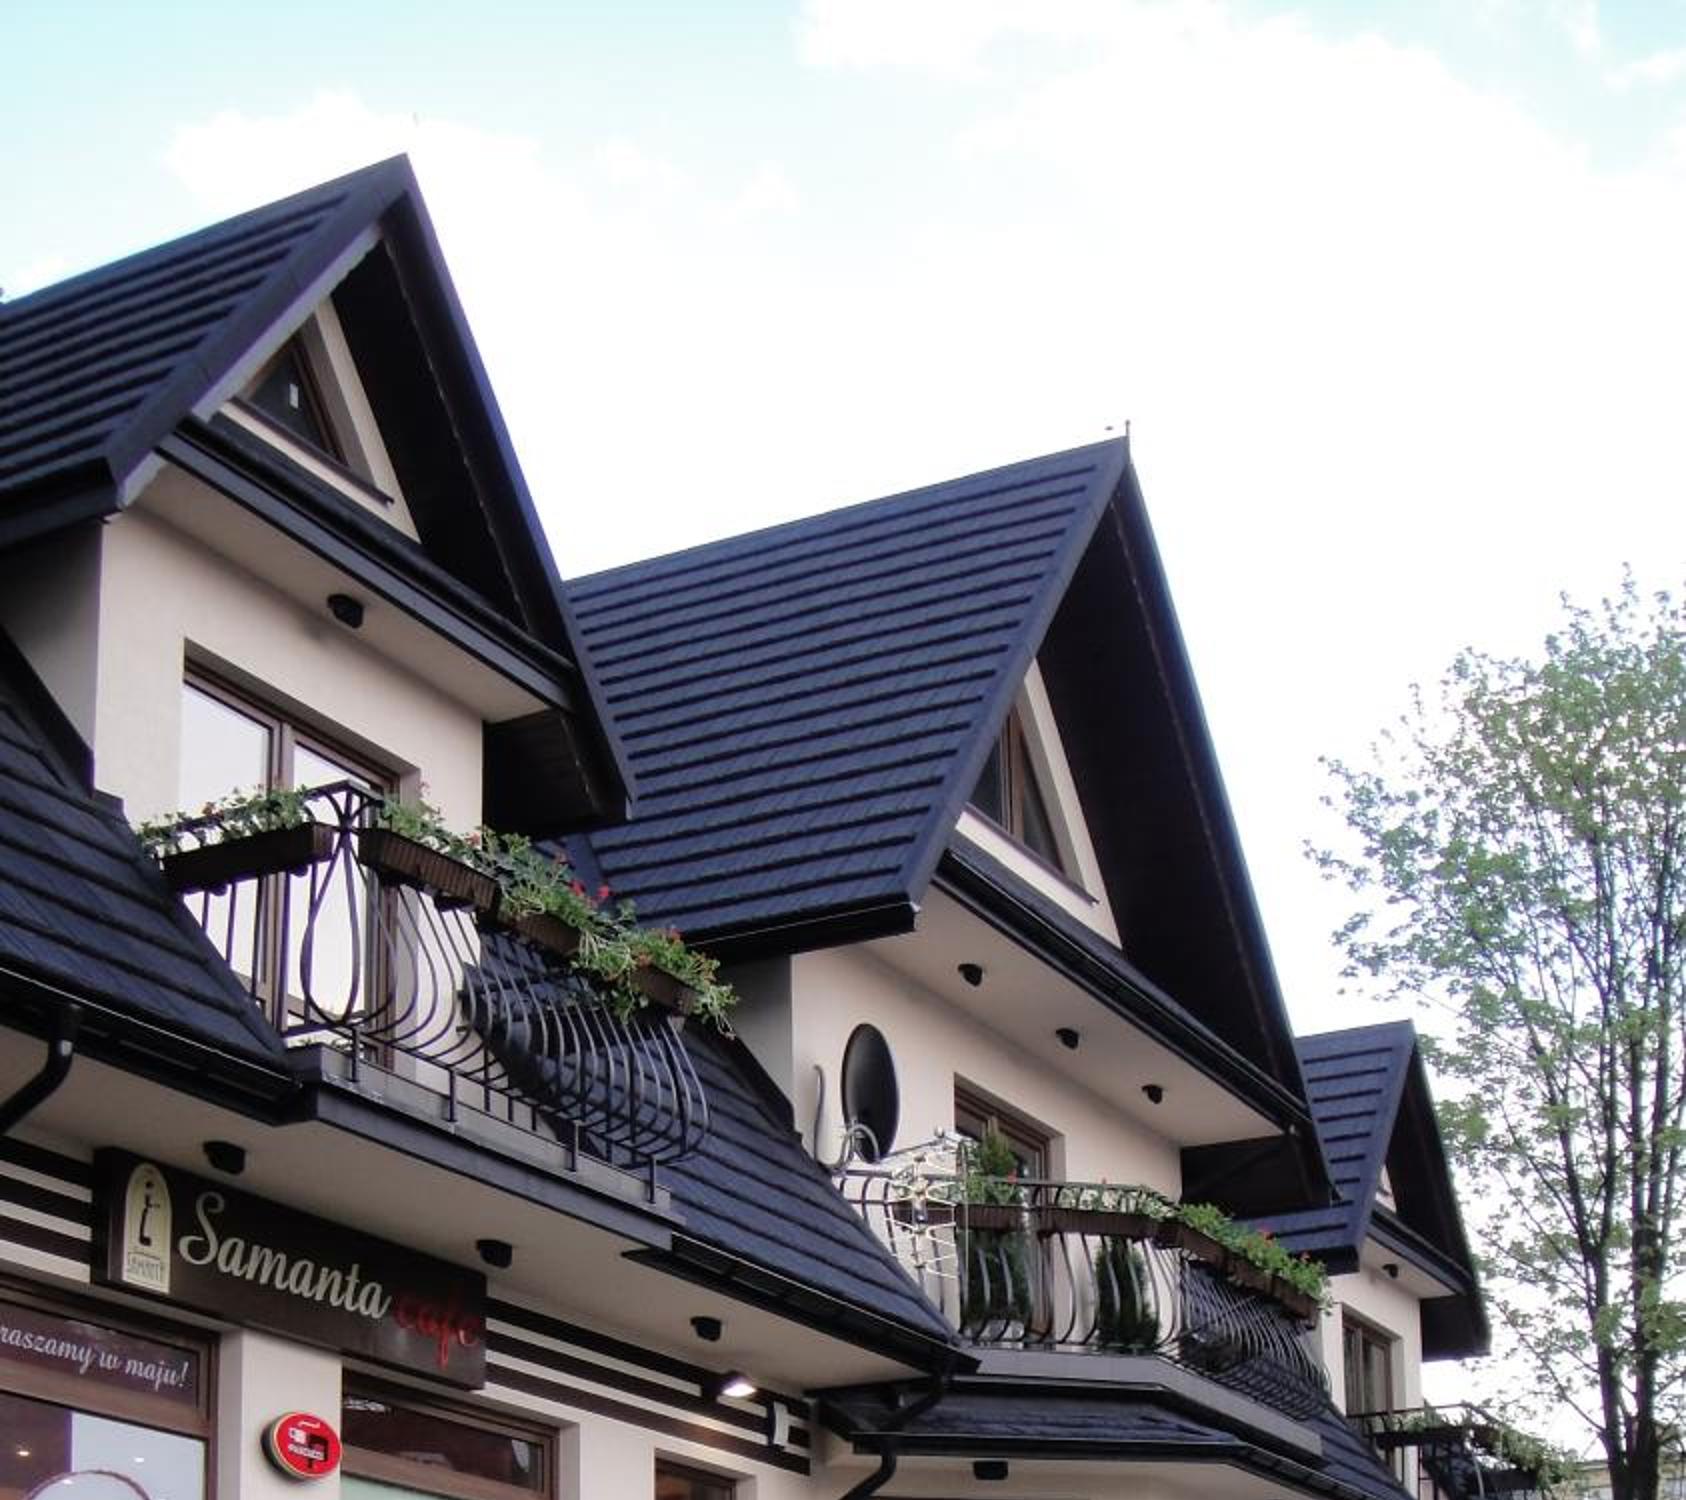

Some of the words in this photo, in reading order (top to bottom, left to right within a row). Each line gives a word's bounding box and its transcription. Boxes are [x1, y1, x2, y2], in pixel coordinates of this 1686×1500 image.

[179, 1191, 392, 1319] Samanta
[99, 1350, 121, 1370] w
[125, 1361, 189, 1391] maju!
